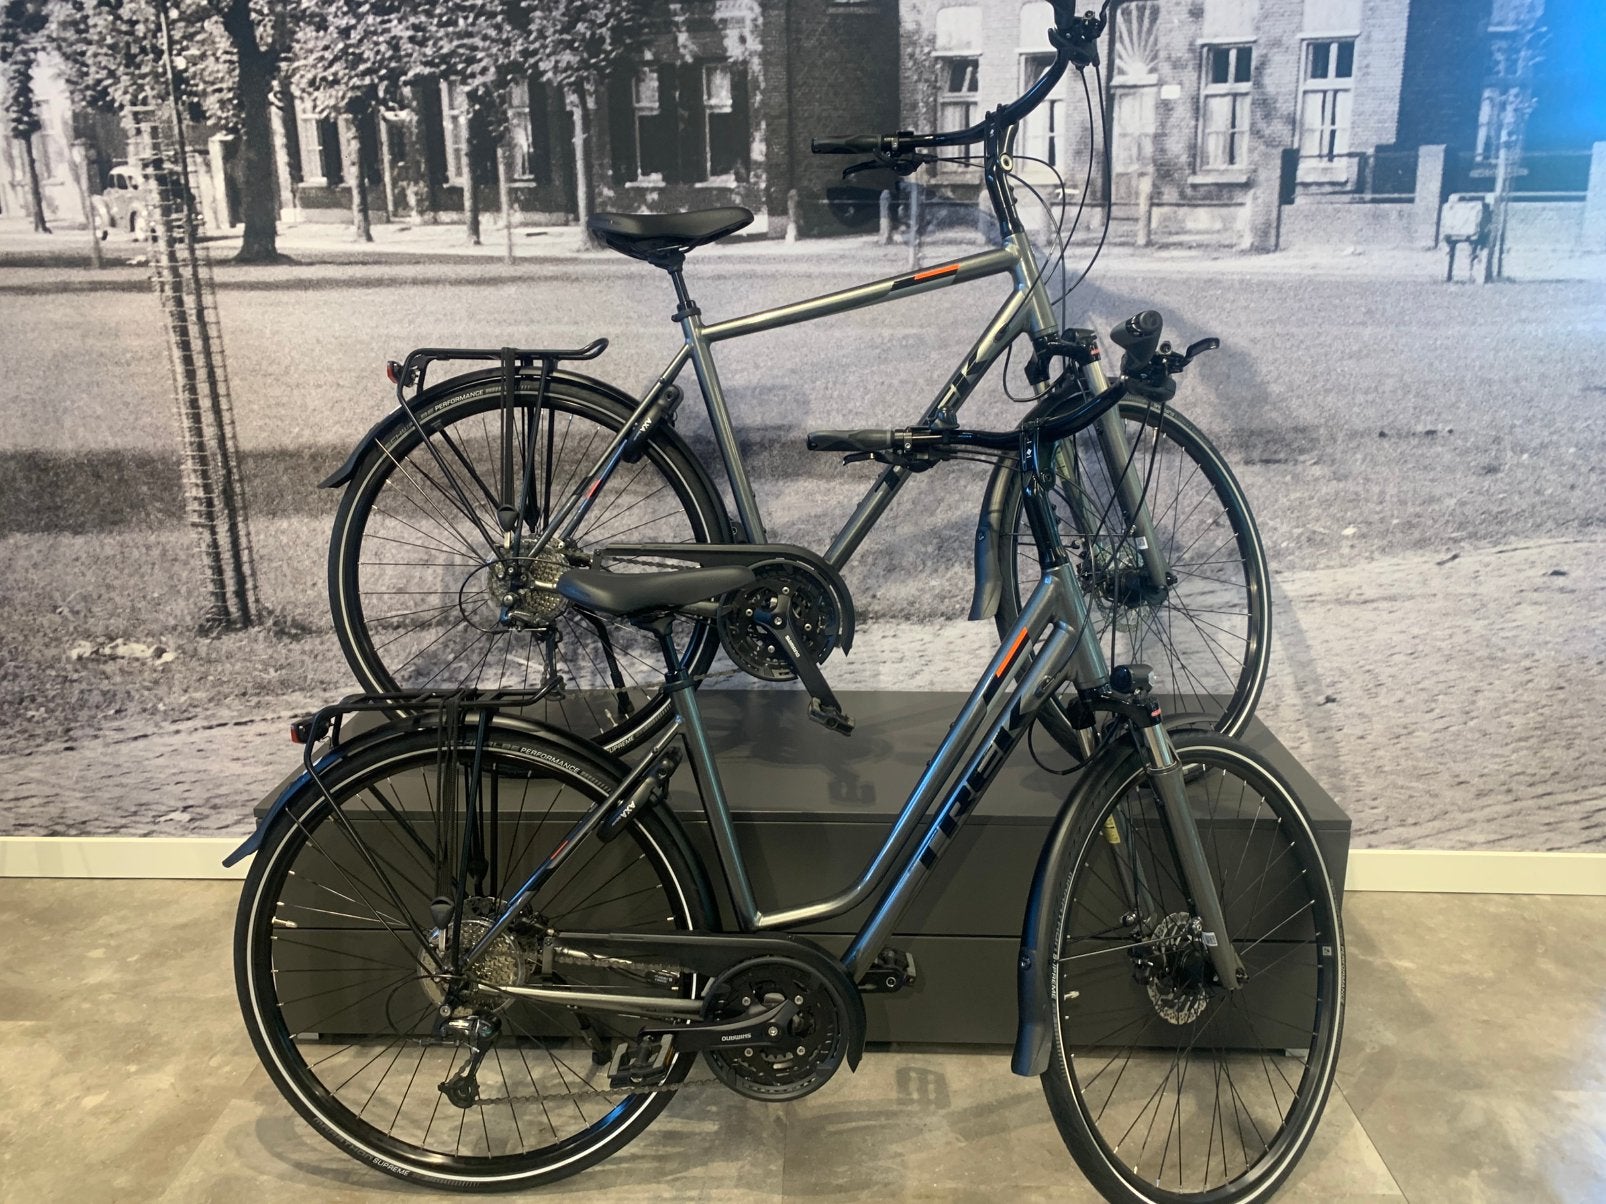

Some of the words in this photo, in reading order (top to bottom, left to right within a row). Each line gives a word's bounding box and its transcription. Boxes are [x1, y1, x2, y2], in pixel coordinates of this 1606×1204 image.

[434, 389, 484, 411] PERFORMANCE
[520, 746, 581, 775] PERFORMANCE
[907, 694, 1037, 875] TREK
[620, 800, 636, 818] AXA
[372, 1157, 411, 1177] SUPREME
